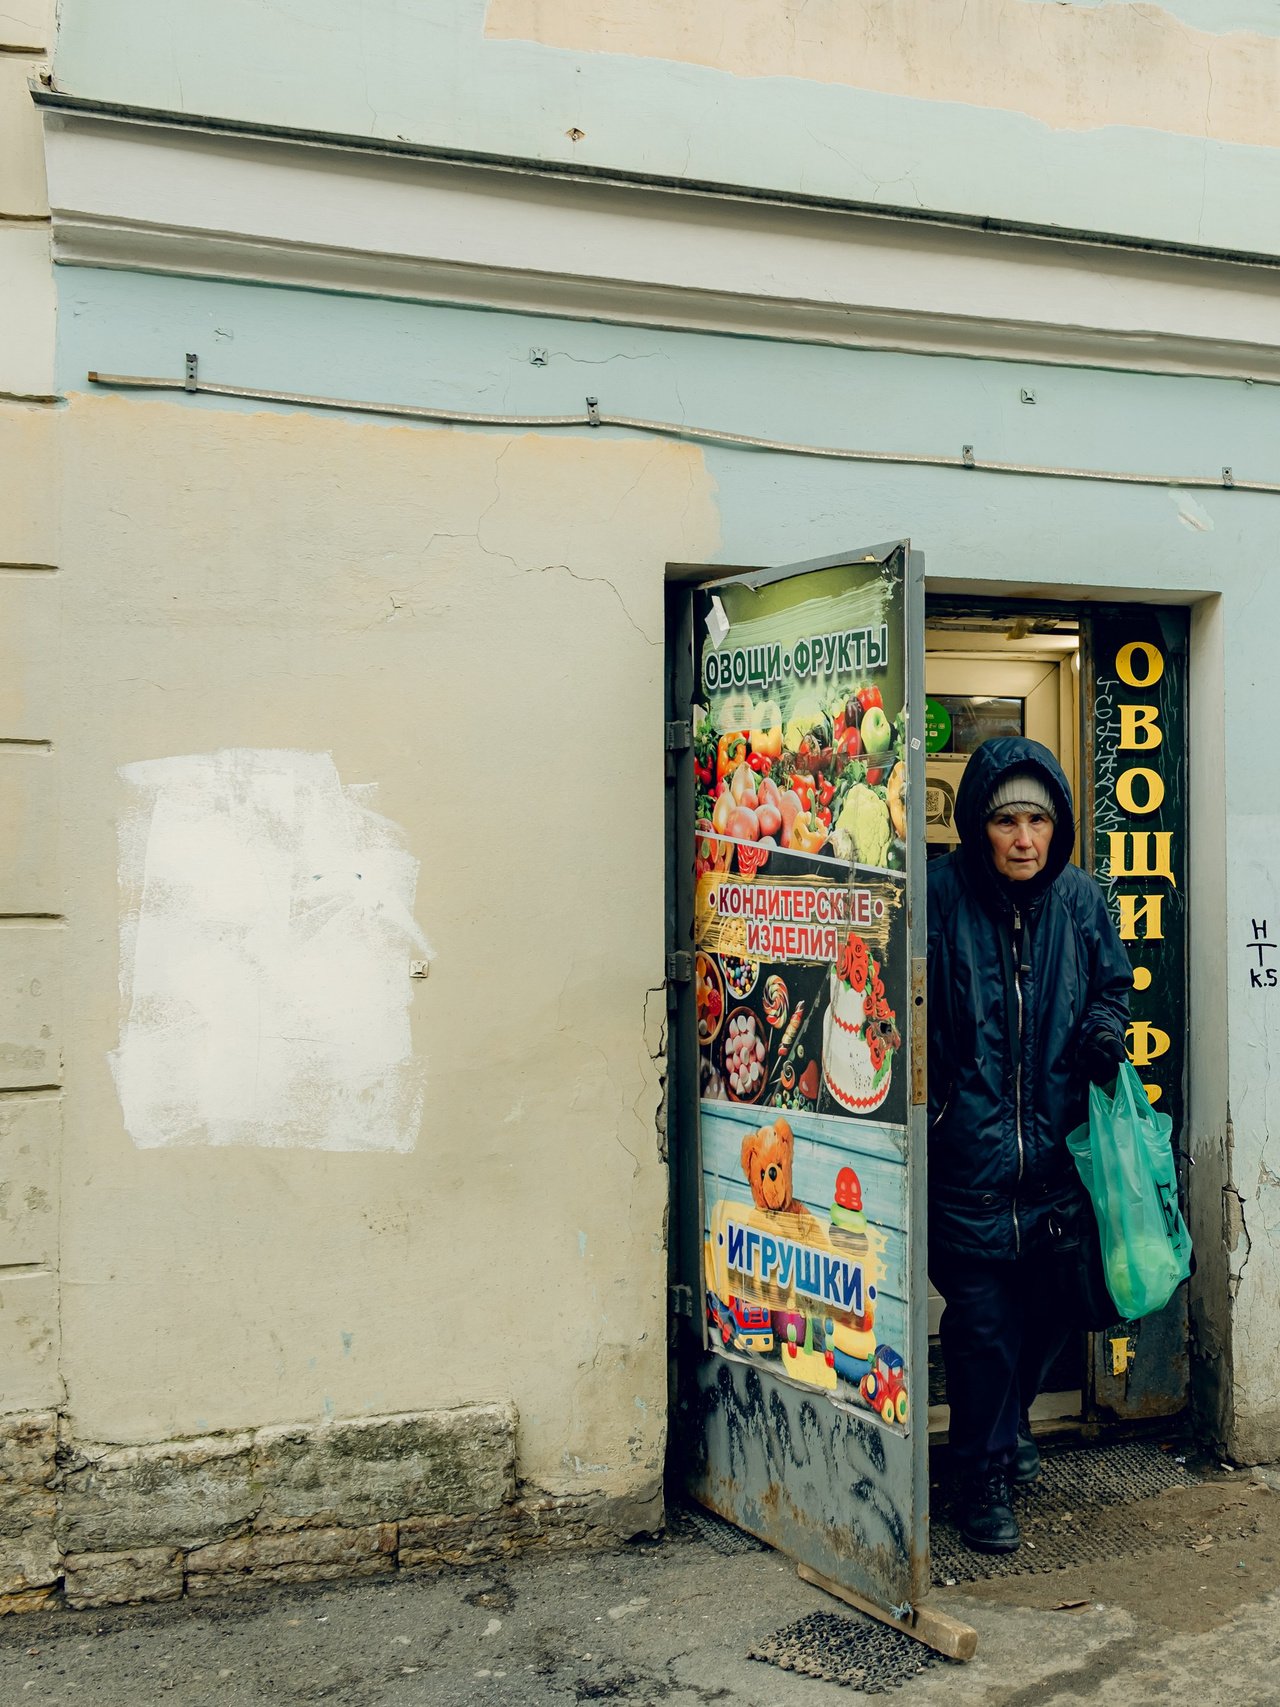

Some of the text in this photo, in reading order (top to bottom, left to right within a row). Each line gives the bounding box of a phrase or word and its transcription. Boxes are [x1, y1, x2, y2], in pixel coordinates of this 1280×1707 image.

[705, 624, 888, 688] ОВОЩИ ФРУКТЫ
[1107, 641, 1176, 940] ОВОЩИ
[718, 884, 872, 926] КОНДИТЕРСКИЕ
[746, 921, 838, 962] ИЗДЕЛИЯ
[726, 1219, 865, 1317] ИГРУШКИ
